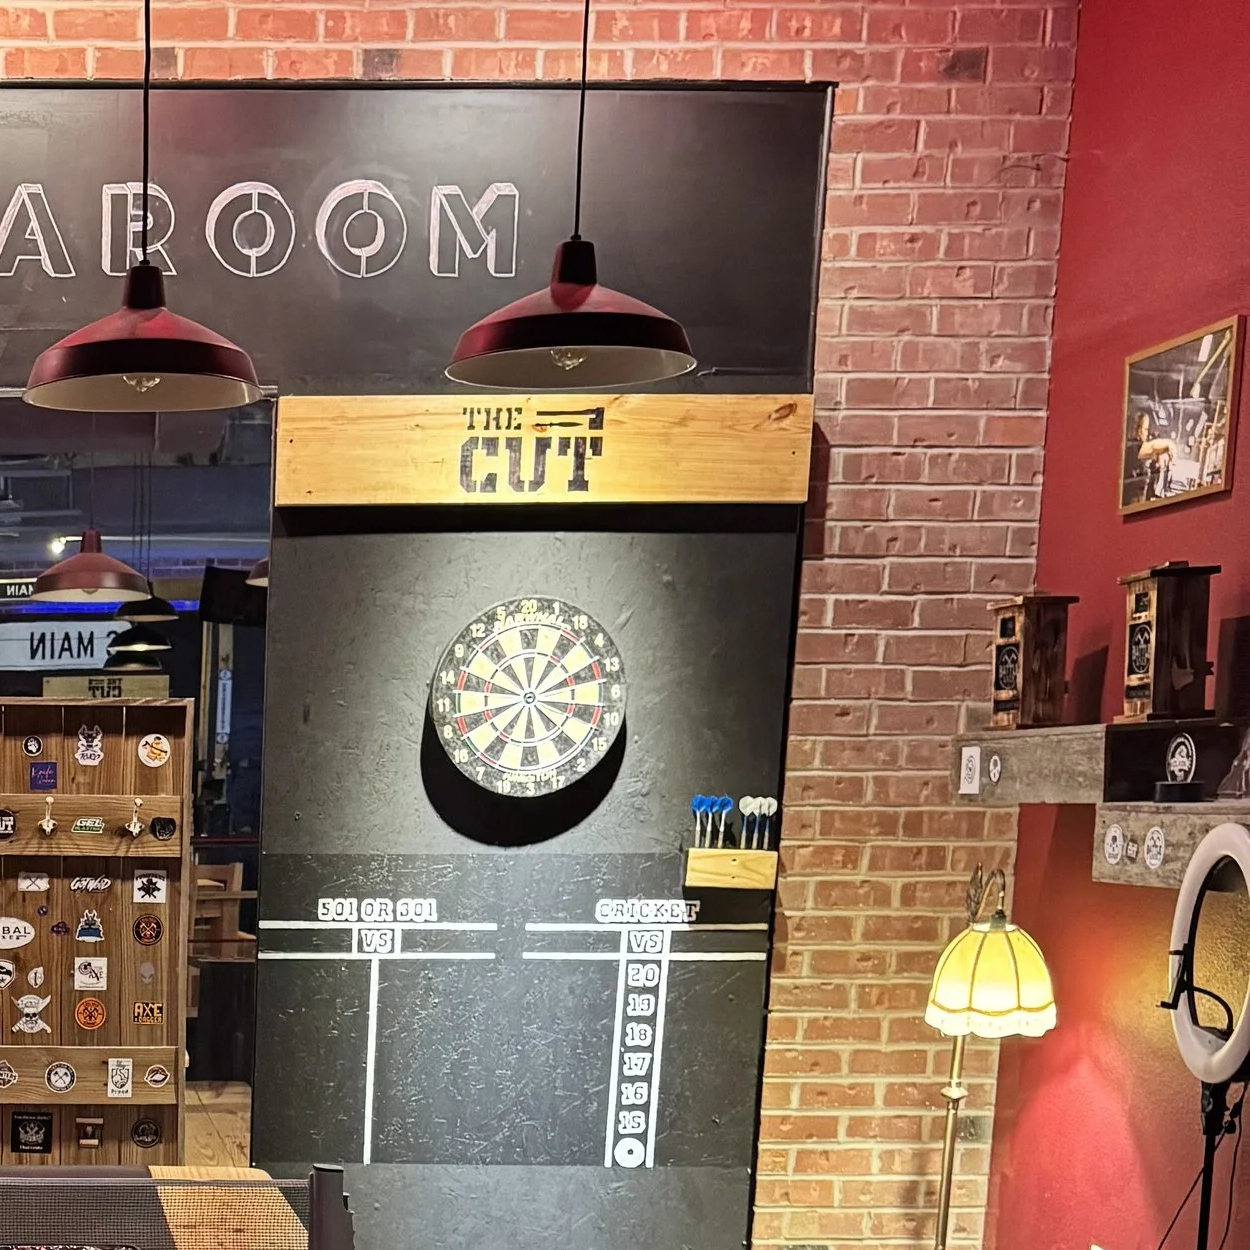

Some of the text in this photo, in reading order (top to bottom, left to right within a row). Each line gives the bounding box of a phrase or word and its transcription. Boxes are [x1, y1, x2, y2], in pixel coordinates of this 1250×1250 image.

[462, 407, 523, 431] THE
[459, 436, 603, 493] CUT
[521, 599, 538, 613] 20
[553, 602, 560, 615] 1
[470, 623, 486, 638] 12
[594, 633, 604, 647] 4
[454, 644, 464, 658] 9
[604, 657, 620, 671] 13
[440, 671, 455, 685] 14
[611, 685, 621, 698] 6
[437, 698, 450, 712] 11
[604, 712, 619, 726] 10
[443, 725, 453, 738] 8
[592, 738, 607, 751] 15
[576, 758, 586, 772] 2
[476, 767, 486, 780] 7
[552, 776, 566, 789] 17
[77, 818, 102, 827] GEL
[318, 898, 437, 922] 501 OR 301
[595, 899, 700, 923] CRICKET
[360, 929, 393, 953] VS
[630, 930, 663, 953] VS
[627, 964, 659, 987] 20
[134, 1003, 162, 1017] AXE
[626, 994, 655, 1016] 19
[625, 1022, 652, 1047] 18
[622, 1053, 652, 1076] 17
[620, 1082, 648, 1105] 16
[618, 1111, 646, 1134] 15
